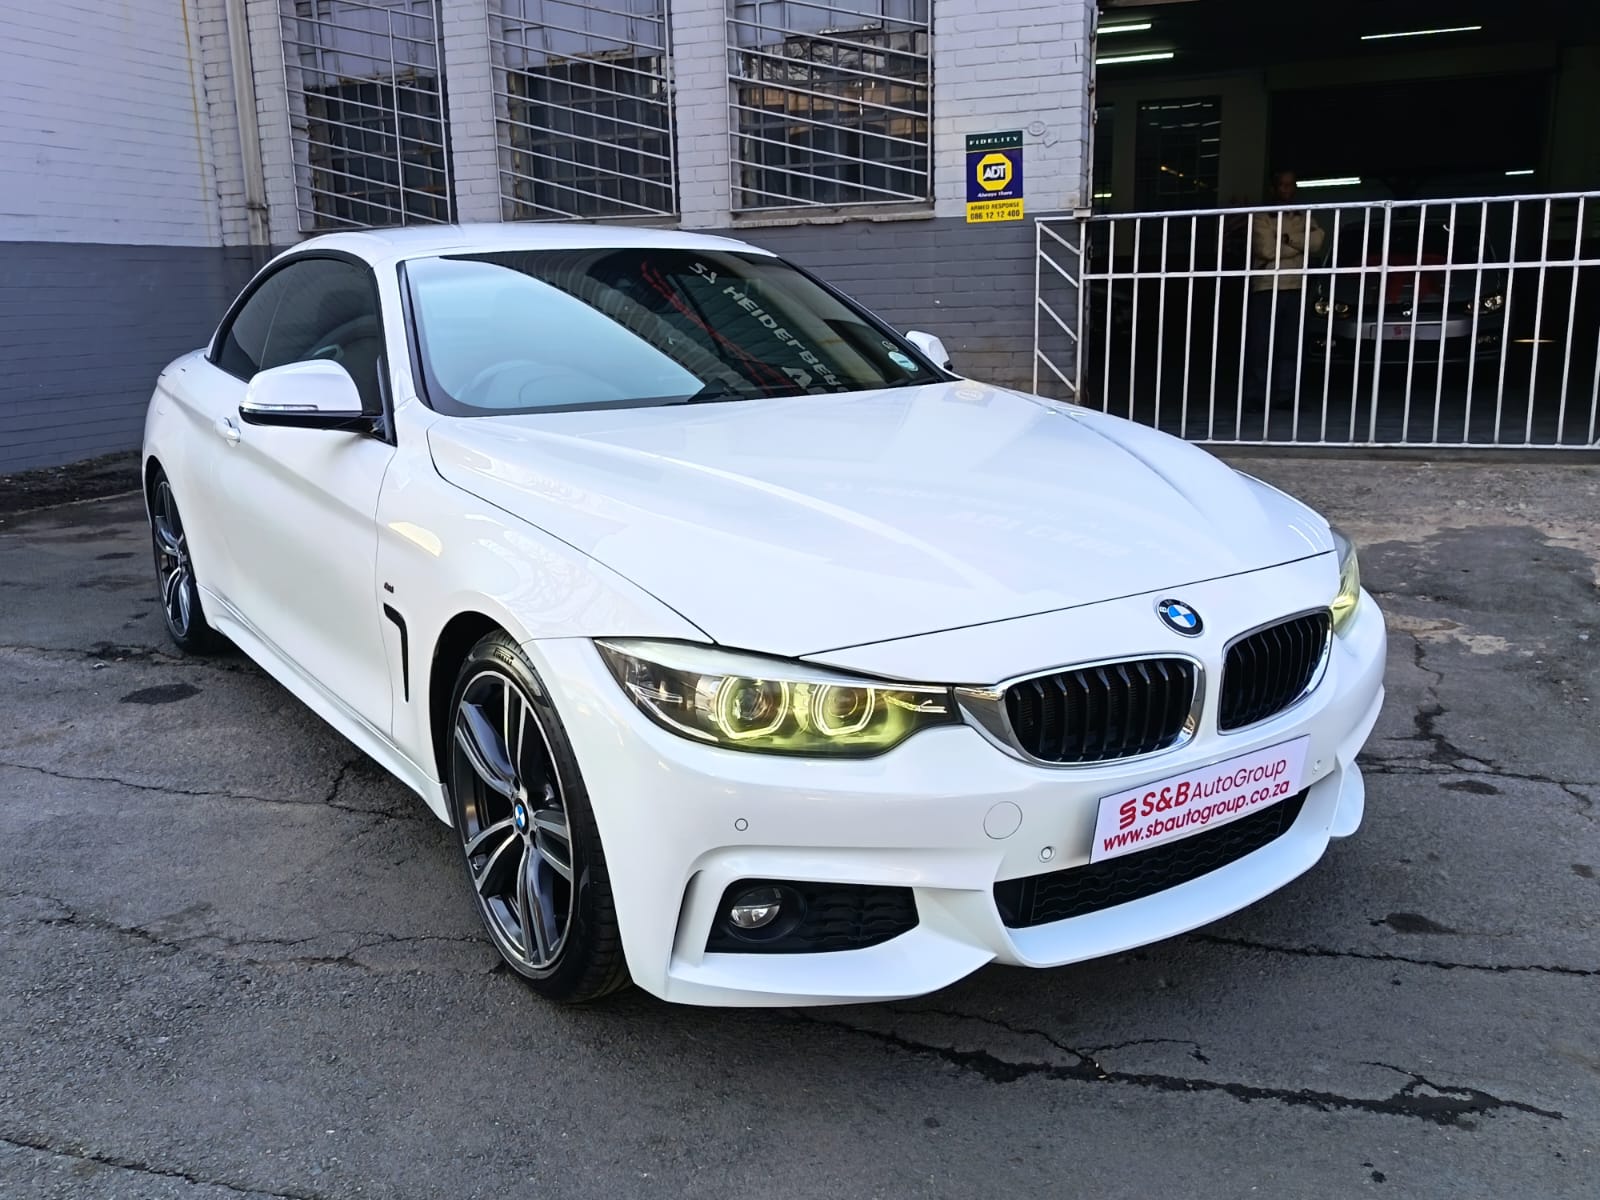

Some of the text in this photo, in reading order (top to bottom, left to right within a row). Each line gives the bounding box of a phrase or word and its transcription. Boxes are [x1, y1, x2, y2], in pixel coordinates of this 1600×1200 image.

[969, 136, 1018, 145] FIDELITY
[983, 164, 1006, 179] ADT
[986, 211, 994, 219] 12
[997, 210, 1005, 218] 12
[1007, 209, 1020, 217] 400
[1141, 759, 1287, 817] S&B AutoGroup
[1103, 780, 1290, 852] www.sbautogroup.co.za
